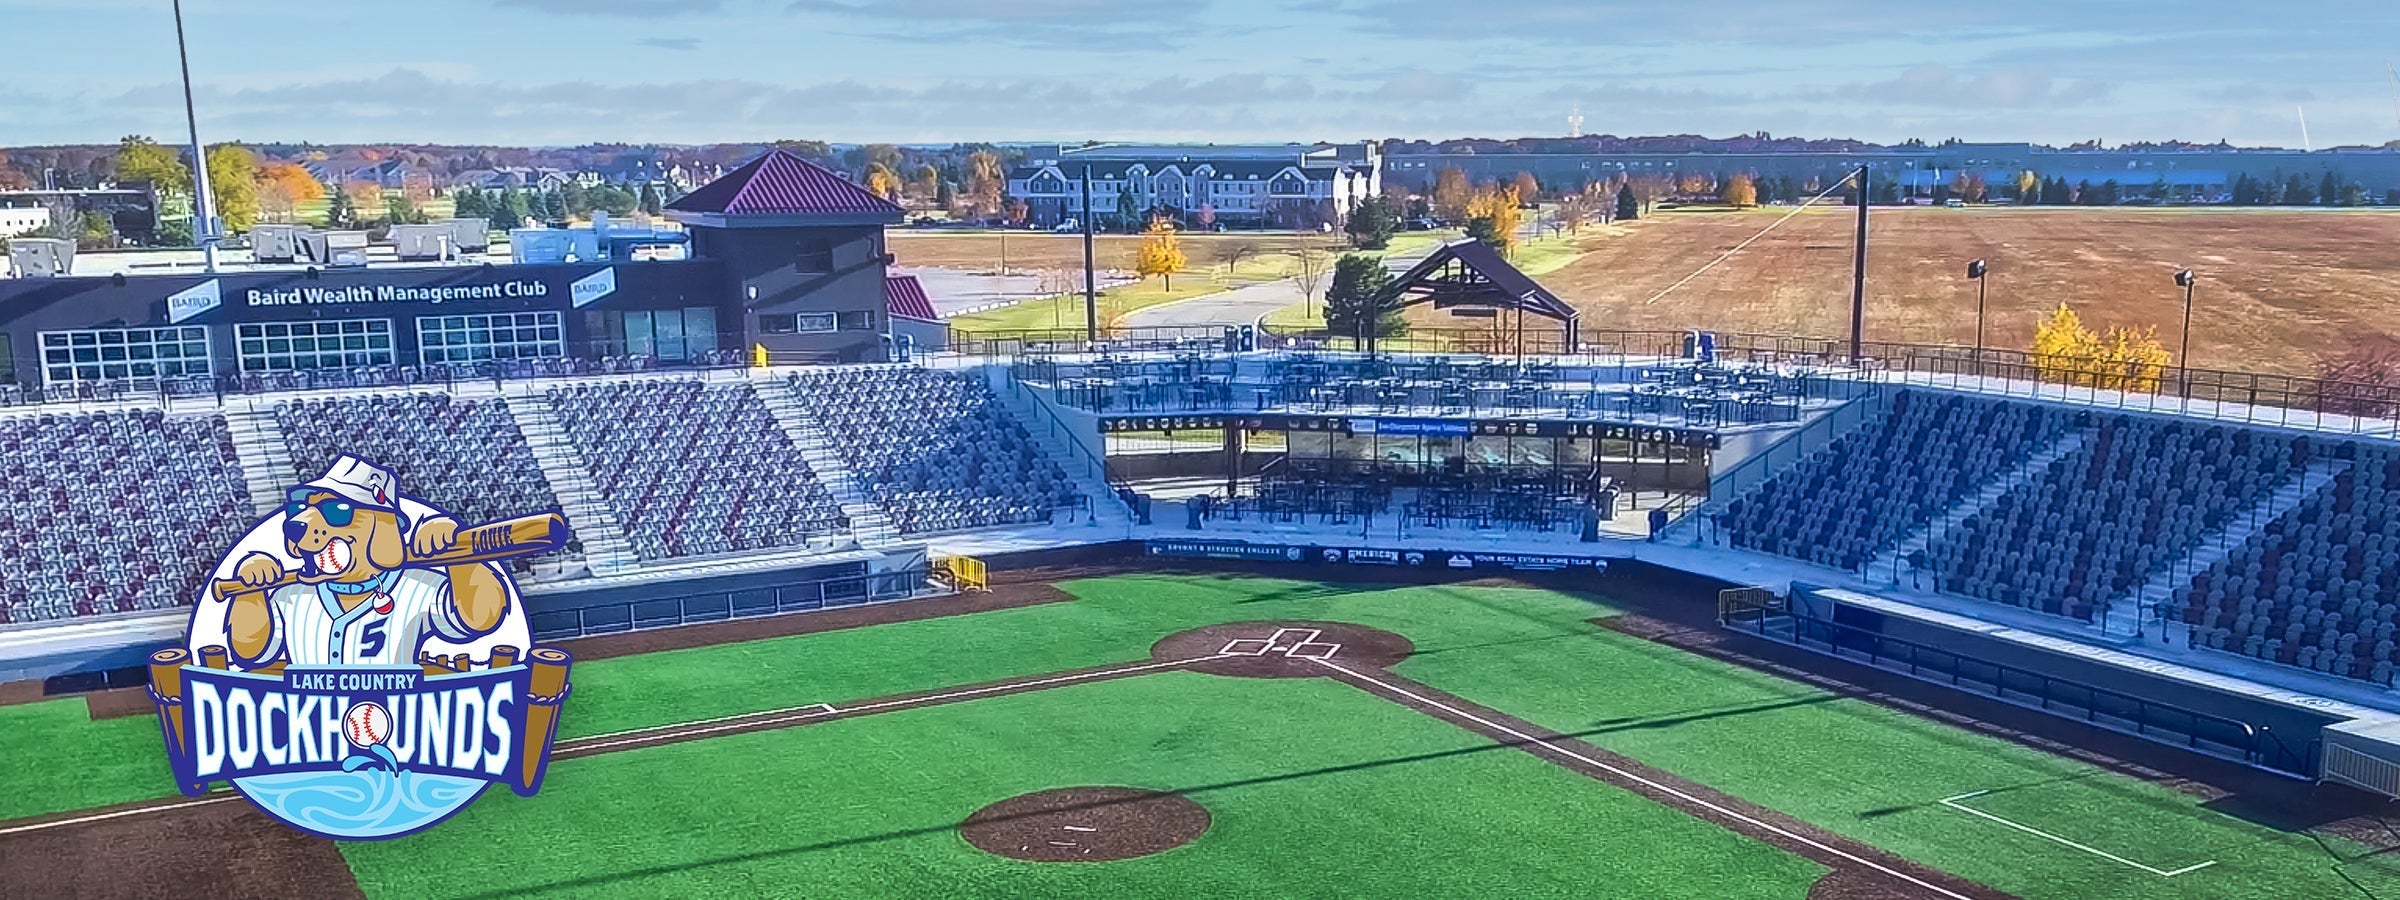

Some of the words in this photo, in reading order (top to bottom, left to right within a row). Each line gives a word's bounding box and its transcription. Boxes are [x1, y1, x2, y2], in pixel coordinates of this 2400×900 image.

[248, 289, 301, 306] Baird
[304, 286, 374, 303] Wealth
[377, 283, 501, 304] Management
[504, 280, 547, 297] Club
[172, 297, 211, 308] BAIRD
